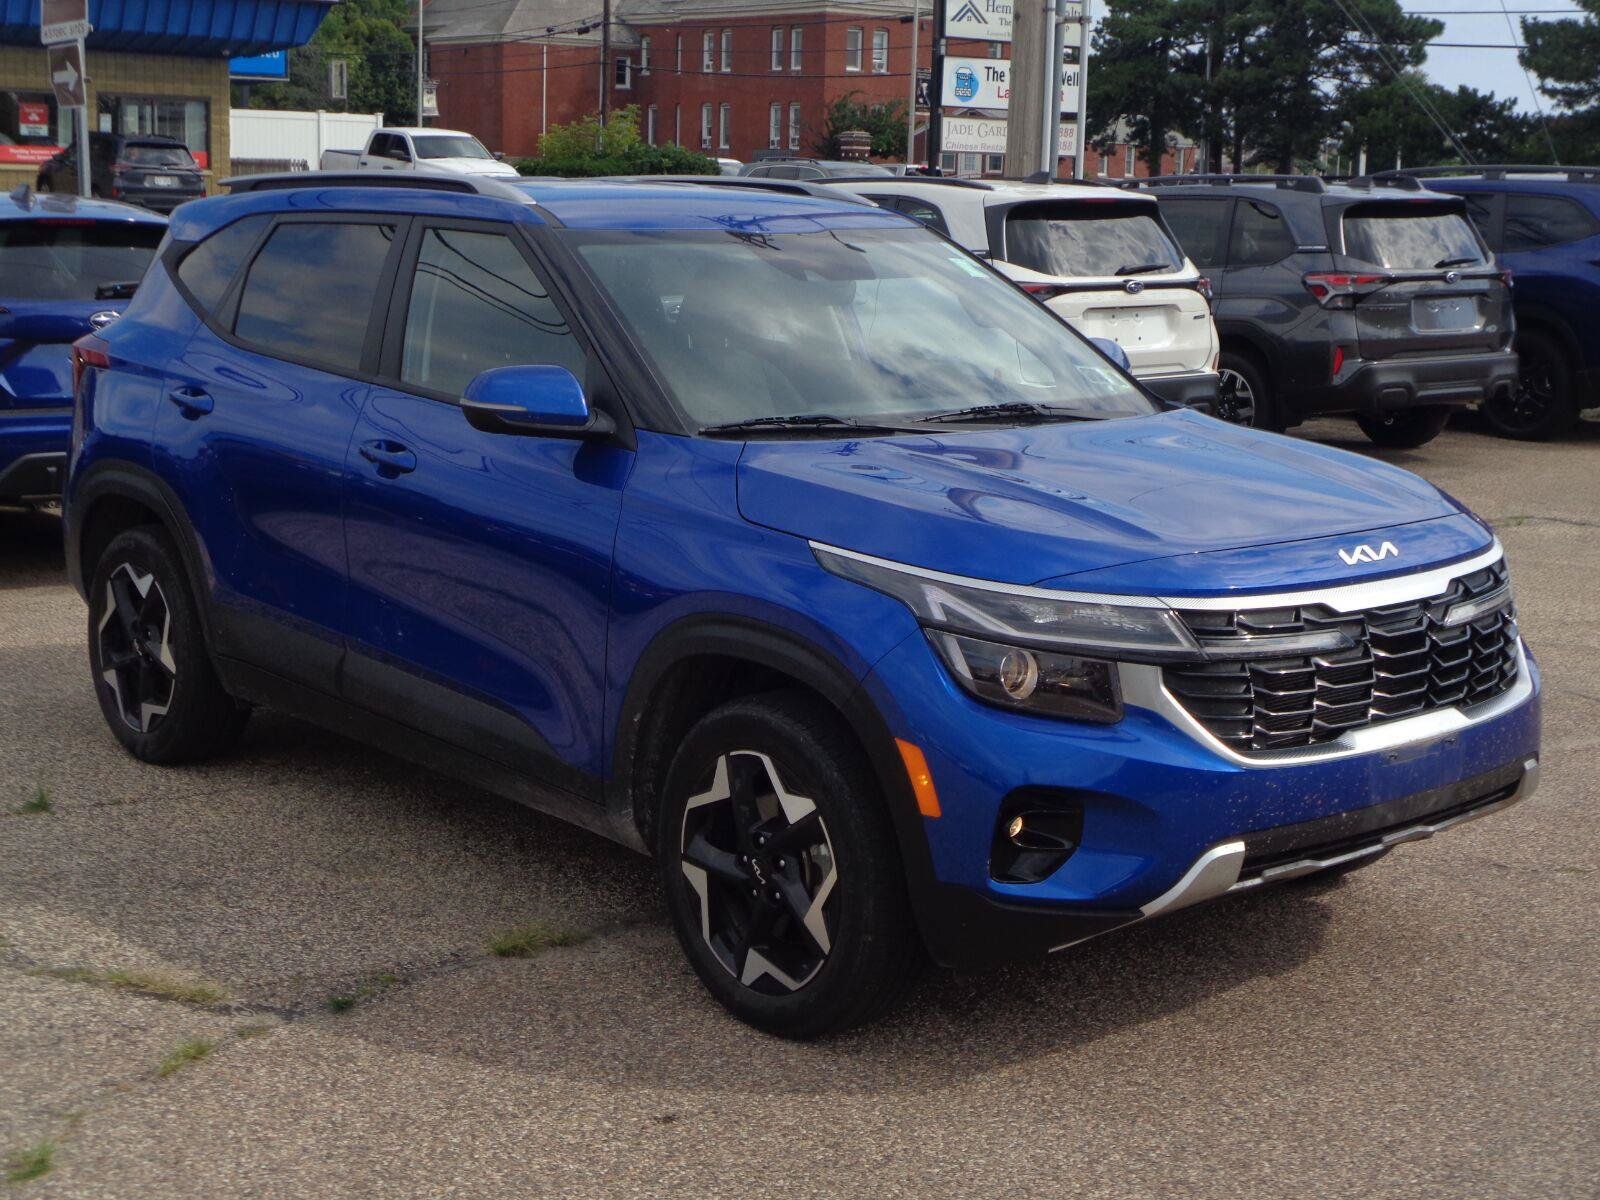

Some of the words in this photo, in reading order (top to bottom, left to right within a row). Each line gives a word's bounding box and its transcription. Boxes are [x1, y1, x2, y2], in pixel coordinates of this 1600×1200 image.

[984, 66, 1005, 82] The
[945, 121, 973, 140] JADE
[945, 140, 978, 151] Chinese
[1338, 541, 1399, 566] KIA
